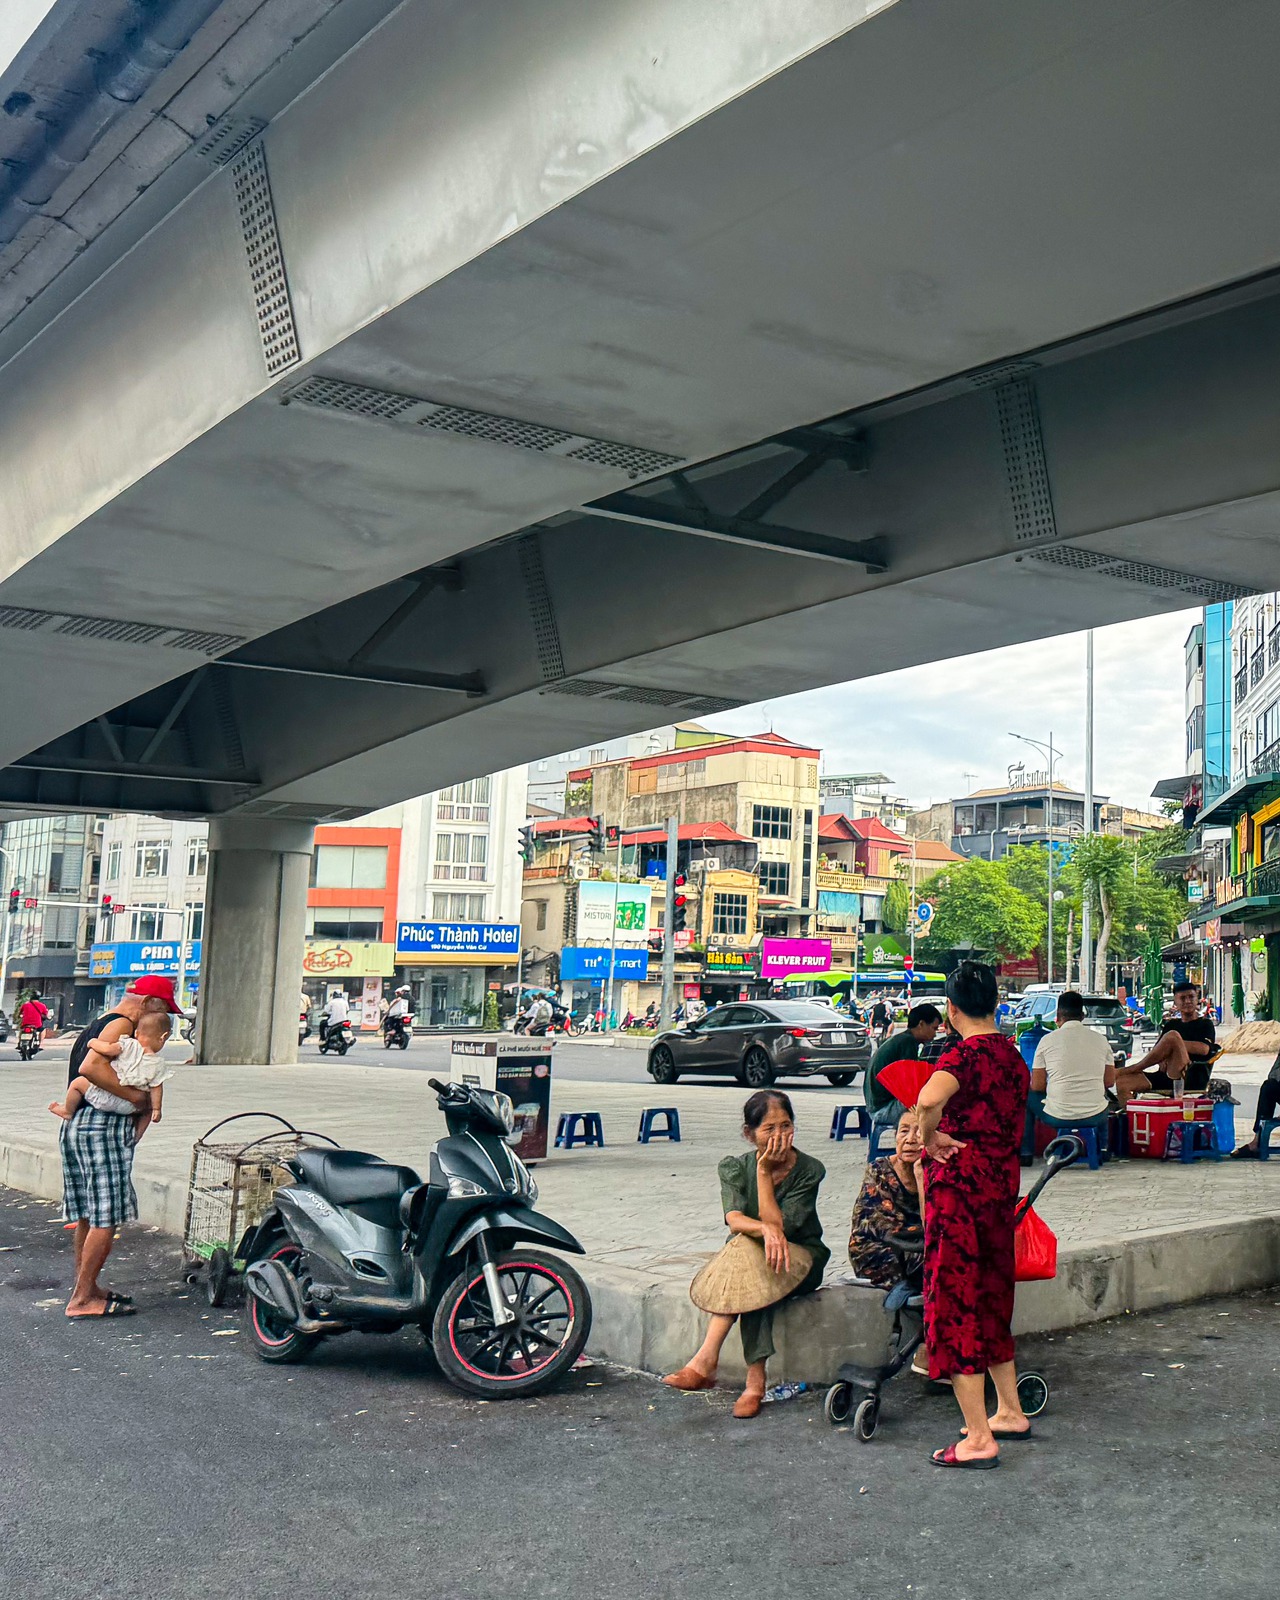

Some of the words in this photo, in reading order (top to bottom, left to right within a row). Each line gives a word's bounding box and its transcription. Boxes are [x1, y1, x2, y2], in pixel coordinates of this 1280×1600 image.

[401, 926, 434, 942] Phúc
[438, 927, 479, 943] Thành
[483, 928, 517, 943] Hotel
[141, 946, 173, 960] PHA
[707, 952, 723, 963] Hải
[725, 952, 743, 964] Sản
[767, 955, 800, 965] KLEVER
[802, 956, 826, 966] FRUIT
